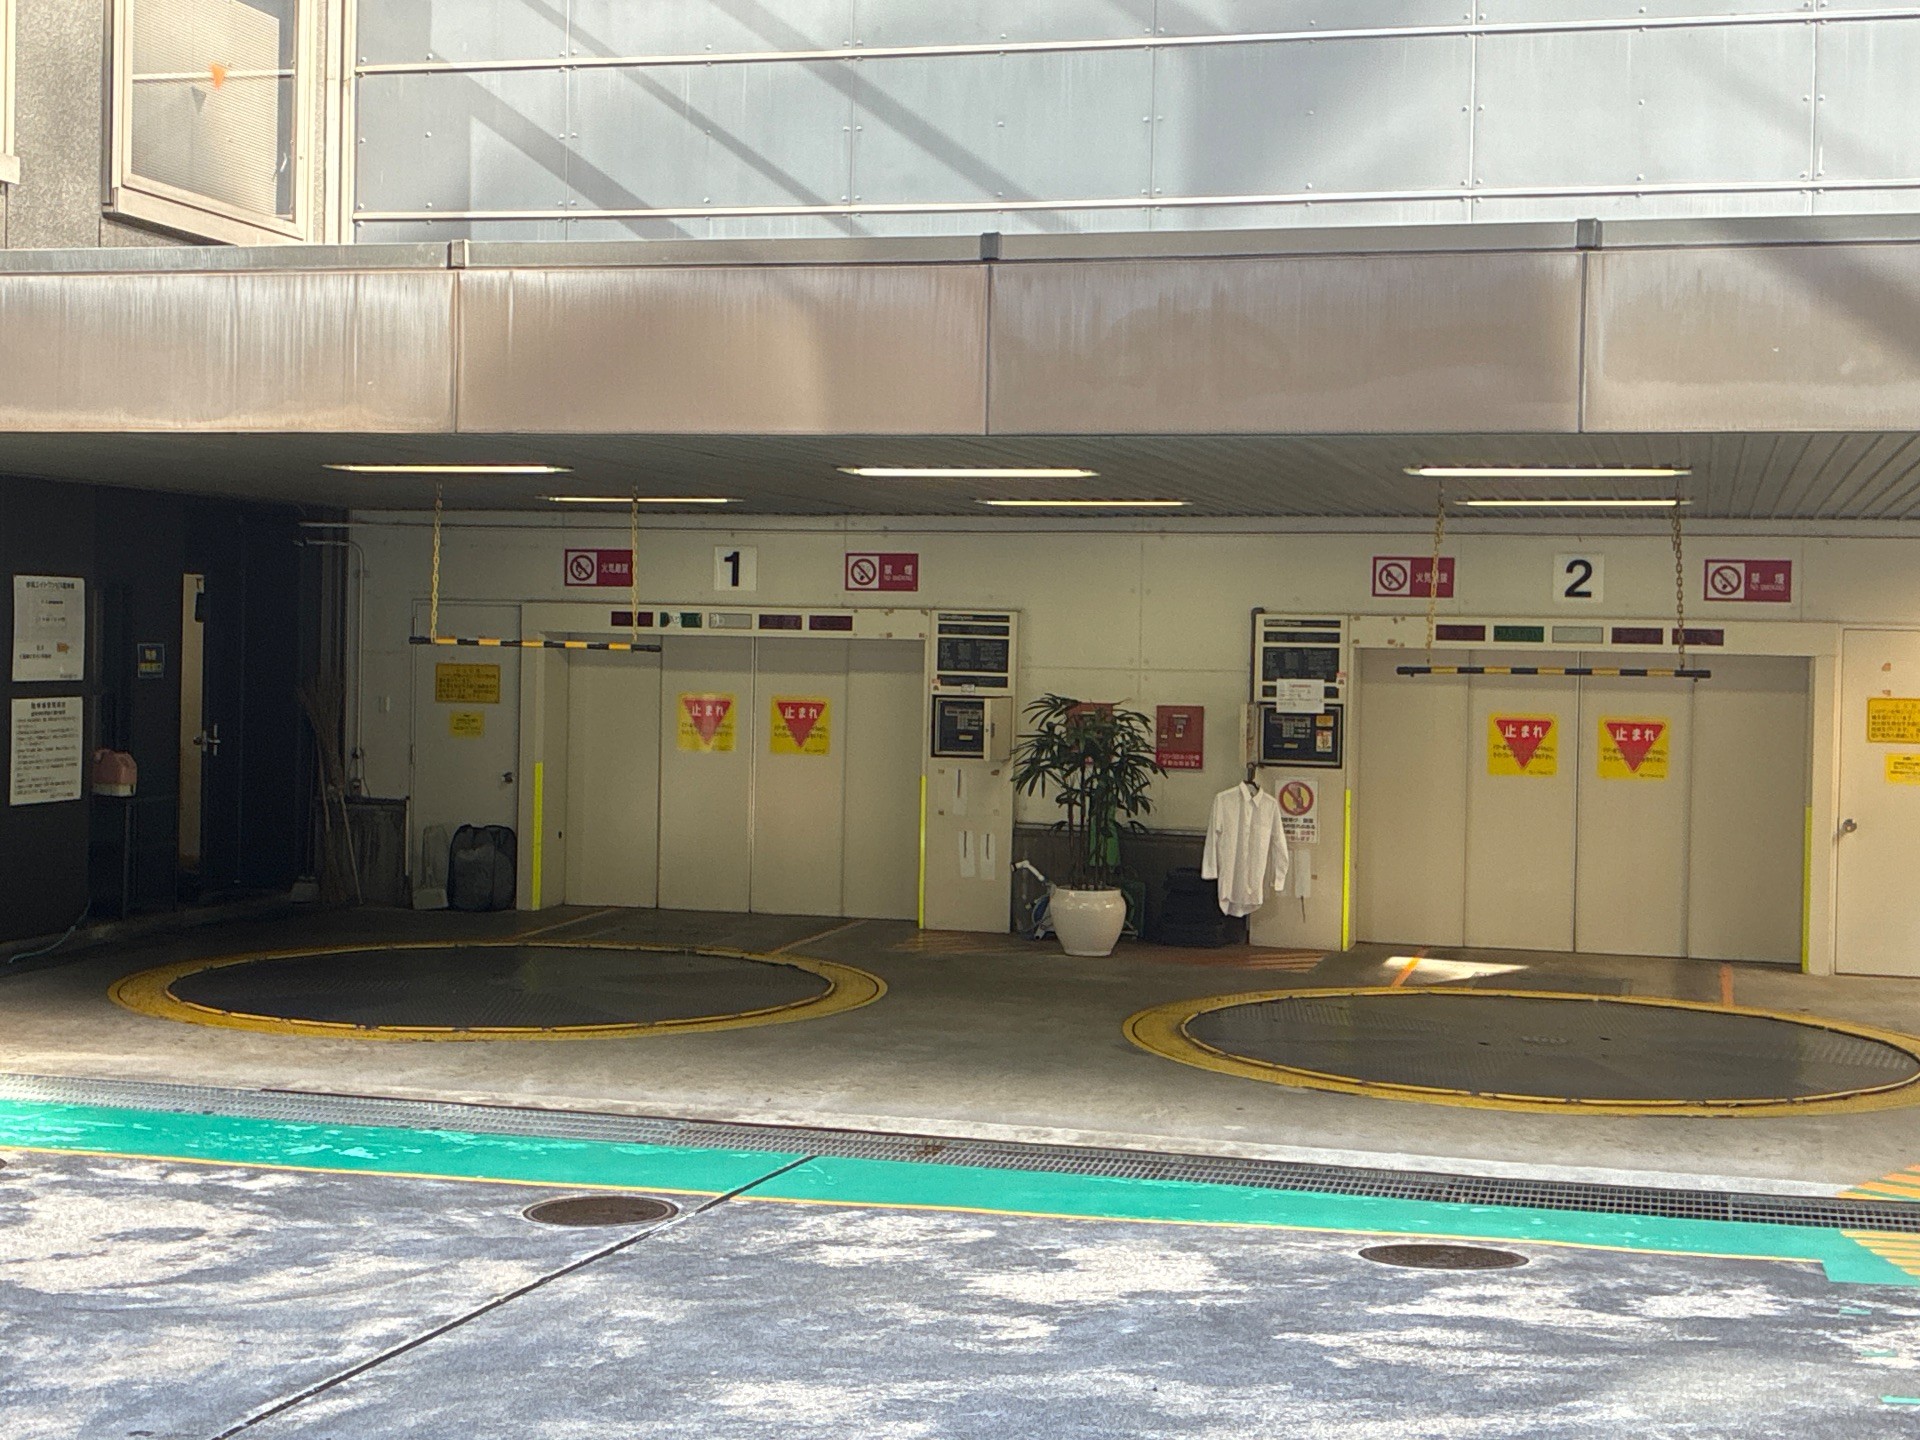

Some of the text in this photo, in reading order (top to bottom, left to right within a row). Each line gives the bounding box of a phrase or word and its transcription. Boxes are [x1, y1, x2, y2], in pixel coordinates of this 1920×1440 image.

[724, 551, 740, 587] 1
[1565, 559, 1592, 597] 2
[691, 704, 724, 717] 止まれ
[784, 706, 818, 719] 止まれ
[1504, 724, 1543, 739] 止まれ
[1616, 728, 1655, 742] 止まれ
